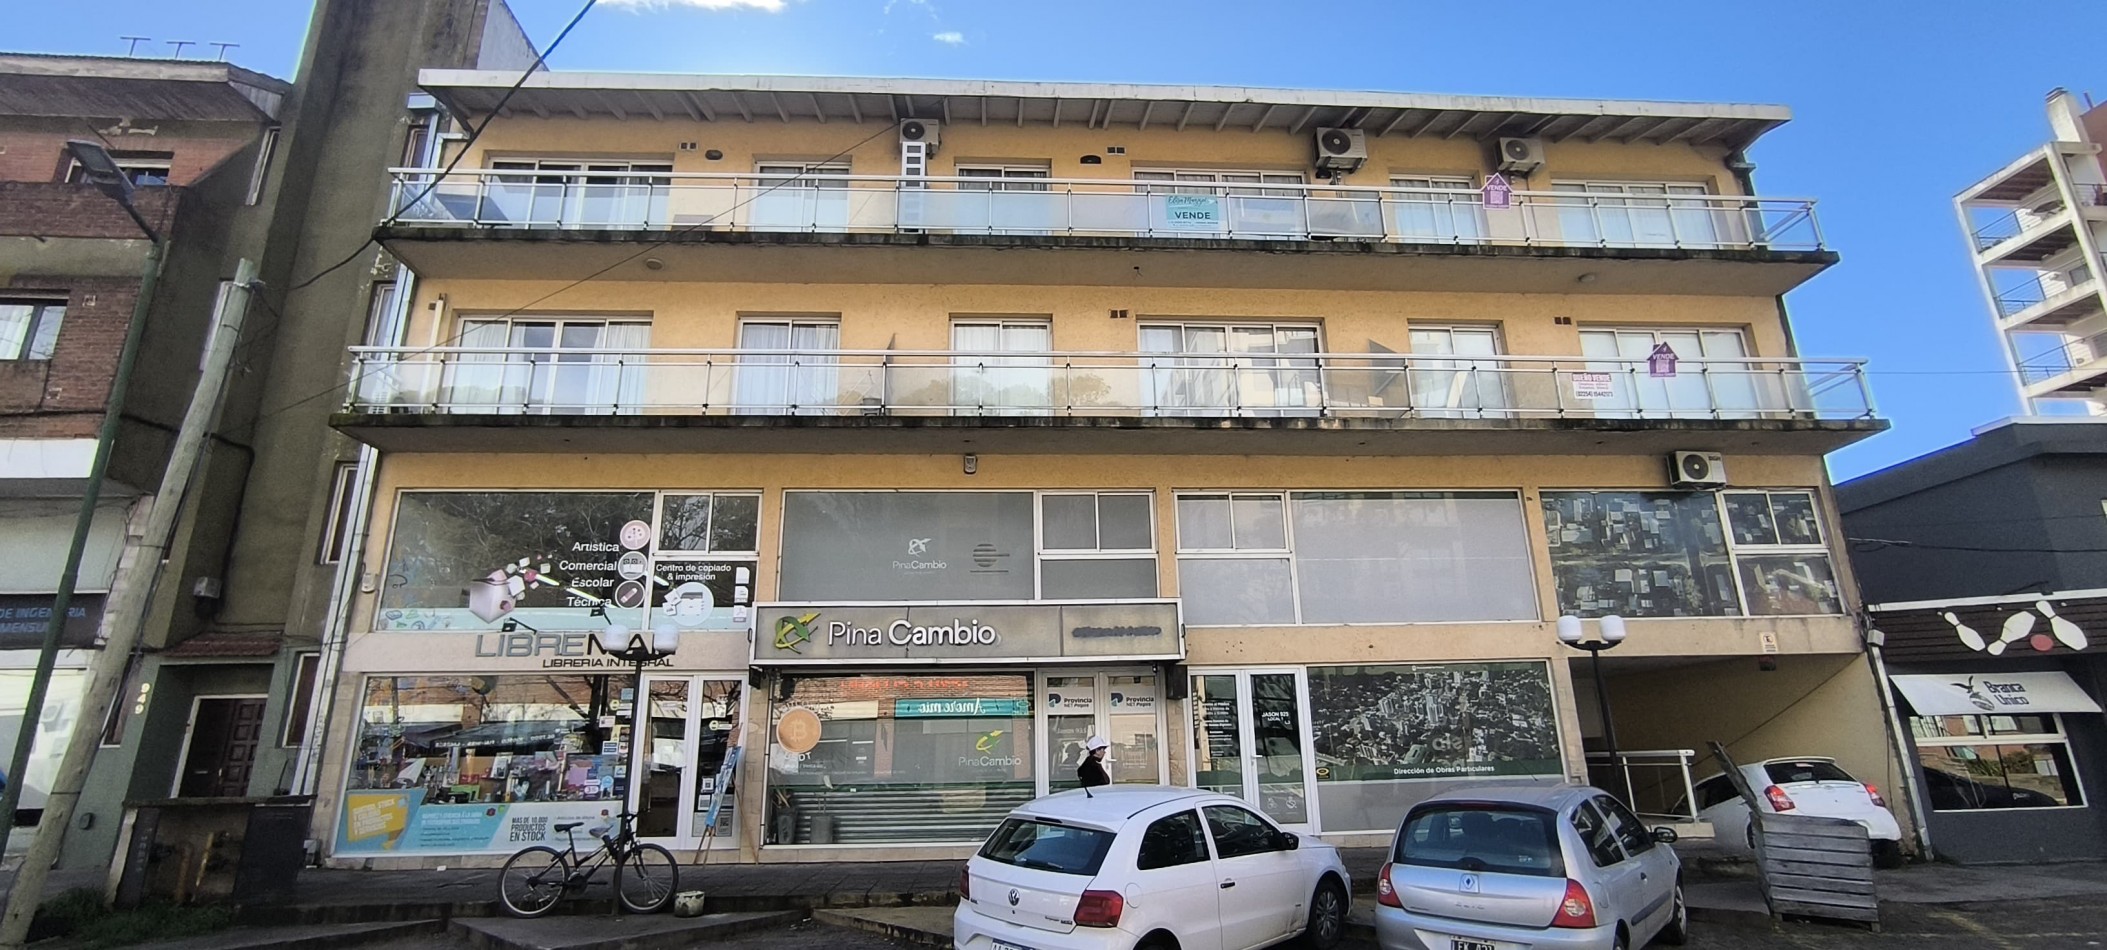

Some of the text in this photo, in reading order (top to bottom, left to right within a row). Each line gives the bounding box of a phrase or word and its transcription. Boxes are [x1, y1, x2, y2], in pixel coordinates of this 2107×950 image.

[1175, 211, 1211, 219] VENDE
[559, 560, 617, 571] Comercial
[656, 564, 731, 574] Centro de copiado
[571, 576, 614, 587] Escolar
[675, 573, 716, 582] impresión
[567, 595, 612, 607] Técnica
[16, 607, 86, 618] INGENRIA
[828, 618, 996, 646] Pina Cambio
[543, 658, 604, 668] LIBRERIA
[1983, 681, 2026, 693] Branca
[1393, 767, 1424, 775] Dirección
[1456, 765, 1495, 773] Particulares
[511, 823, 547, 832] PRODUCTOS
[510, 832, 520, 841] EN
[521, 831, 546, 841] STOCK
